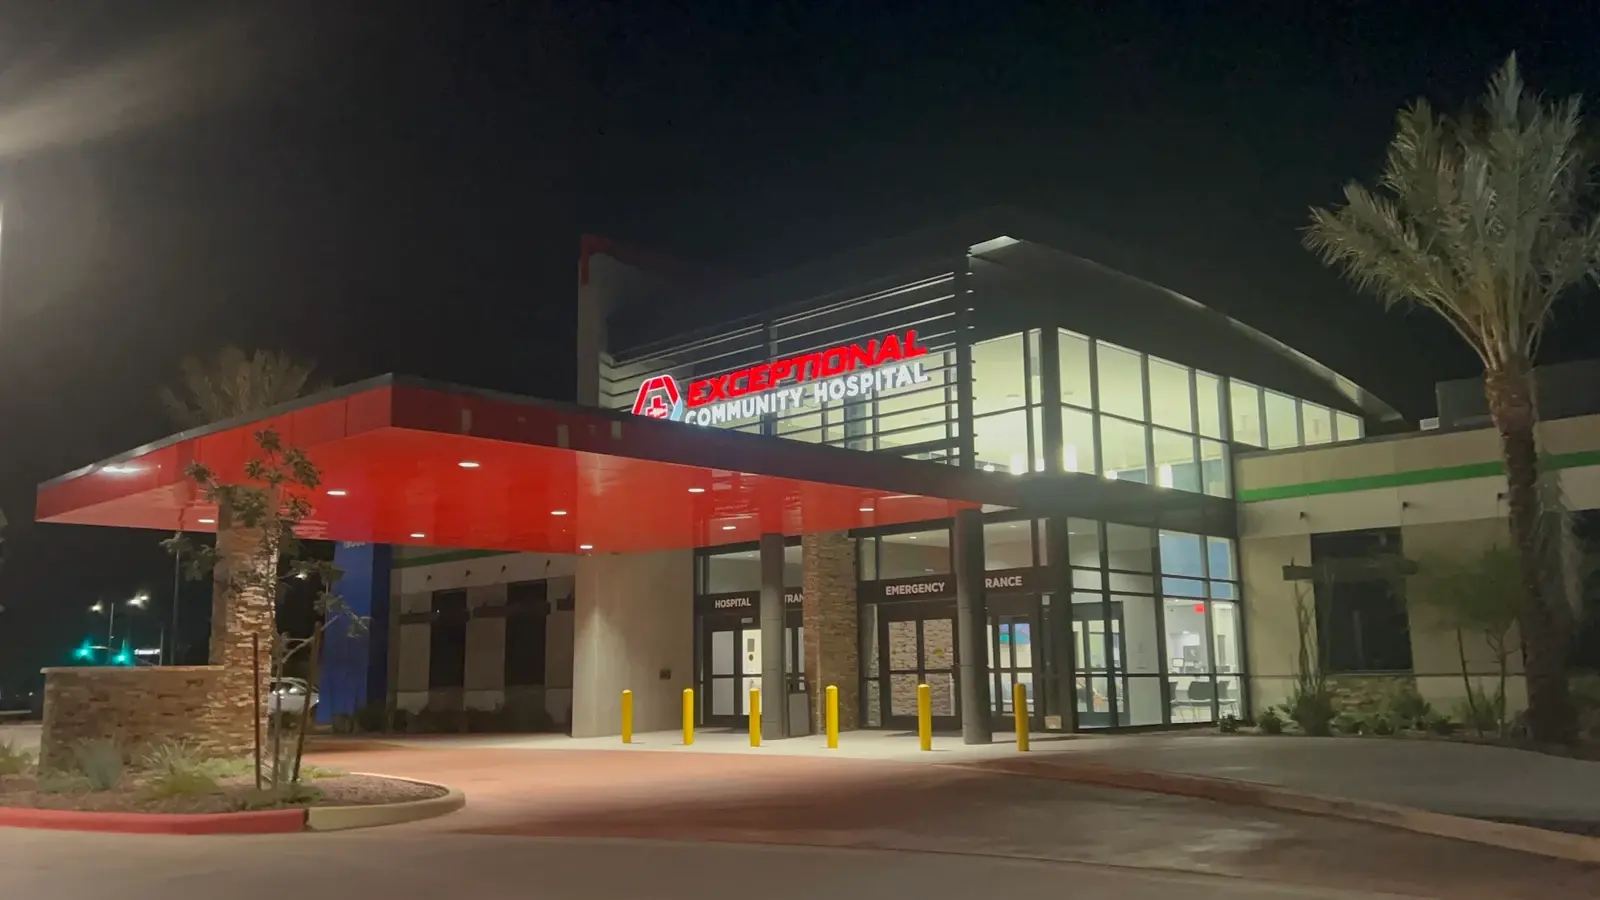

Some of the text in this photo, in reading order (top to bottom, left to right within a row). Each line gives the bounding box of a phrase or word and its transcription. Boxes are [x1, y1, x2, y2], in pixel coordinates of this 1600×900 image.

[687, 329, 928, 408] EXCEPTIONAL
[685, 362, 929, 426] COMMUNITY HOSPITAL
[714, 597, 752, 609] HOSPITAL
[885, 575, 1023, 596] EMERGENCY RANCE
